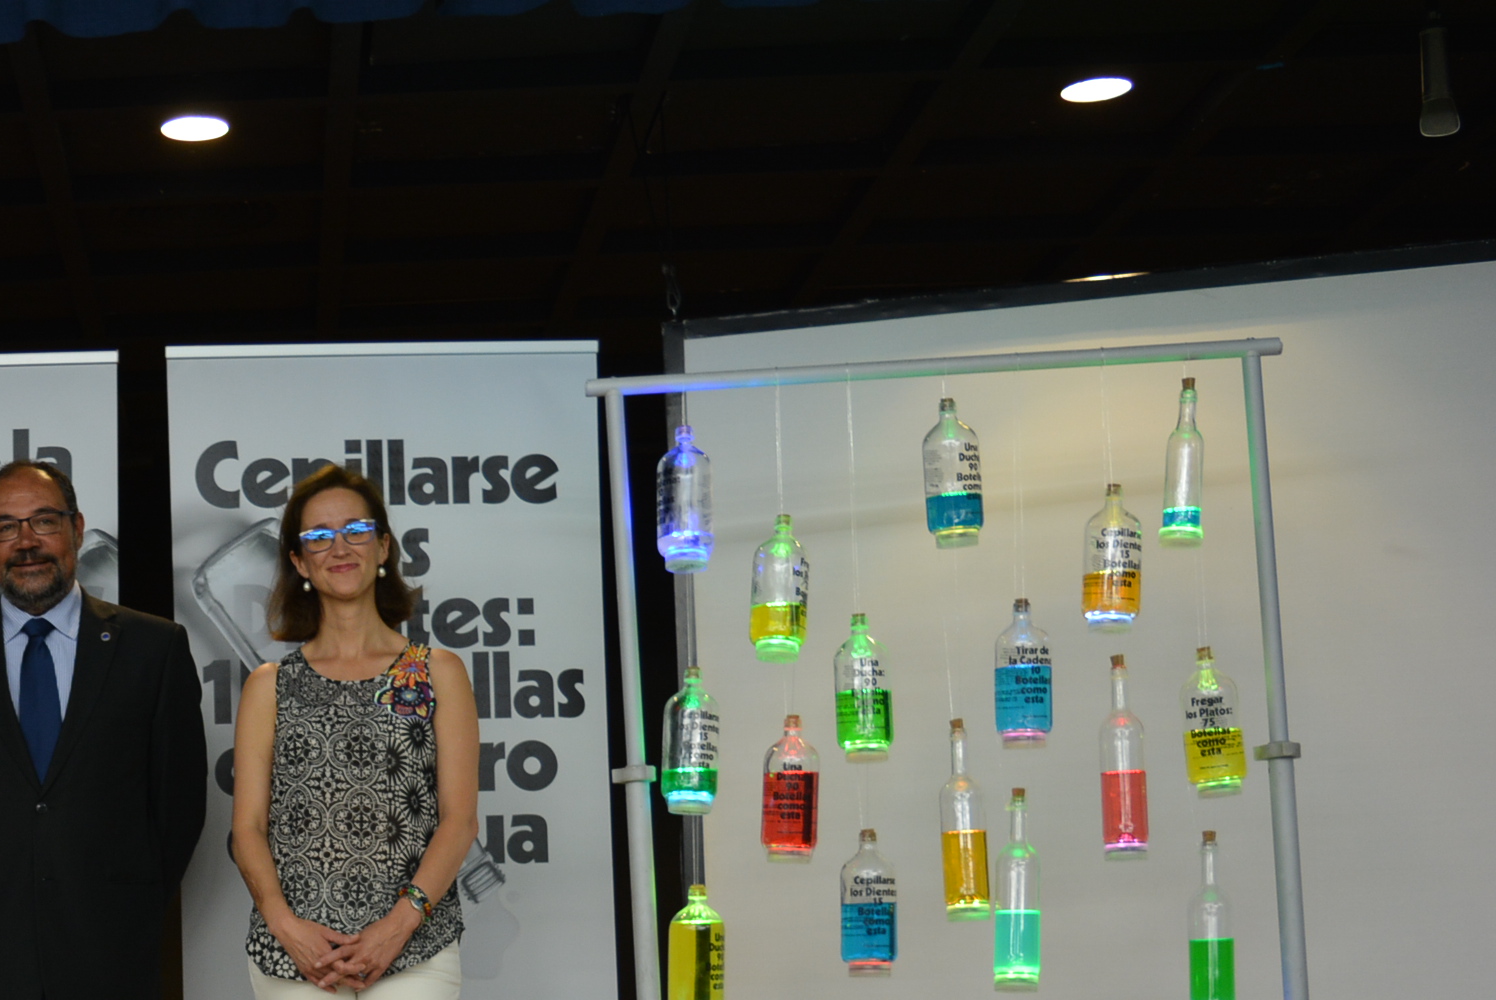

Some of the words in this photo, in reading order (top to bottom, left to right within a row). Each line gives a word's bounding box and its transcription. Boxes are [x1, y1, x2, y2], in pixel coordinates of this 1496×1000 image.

[1016, 646, 1038, 655] Tirar
[864, 678, 877, 686] 90
[1021, 686, 1047, 694] como
[1024, 695, 1043, 704] esta
[1191, 696, 1223, 706] Fregar
[1186, 710, 1197, 719] los
[1199, 707, 1232, 718] Platos:
[1202, 718, 1215, 726] 75
[1200, 748, 1222, 757] esta
